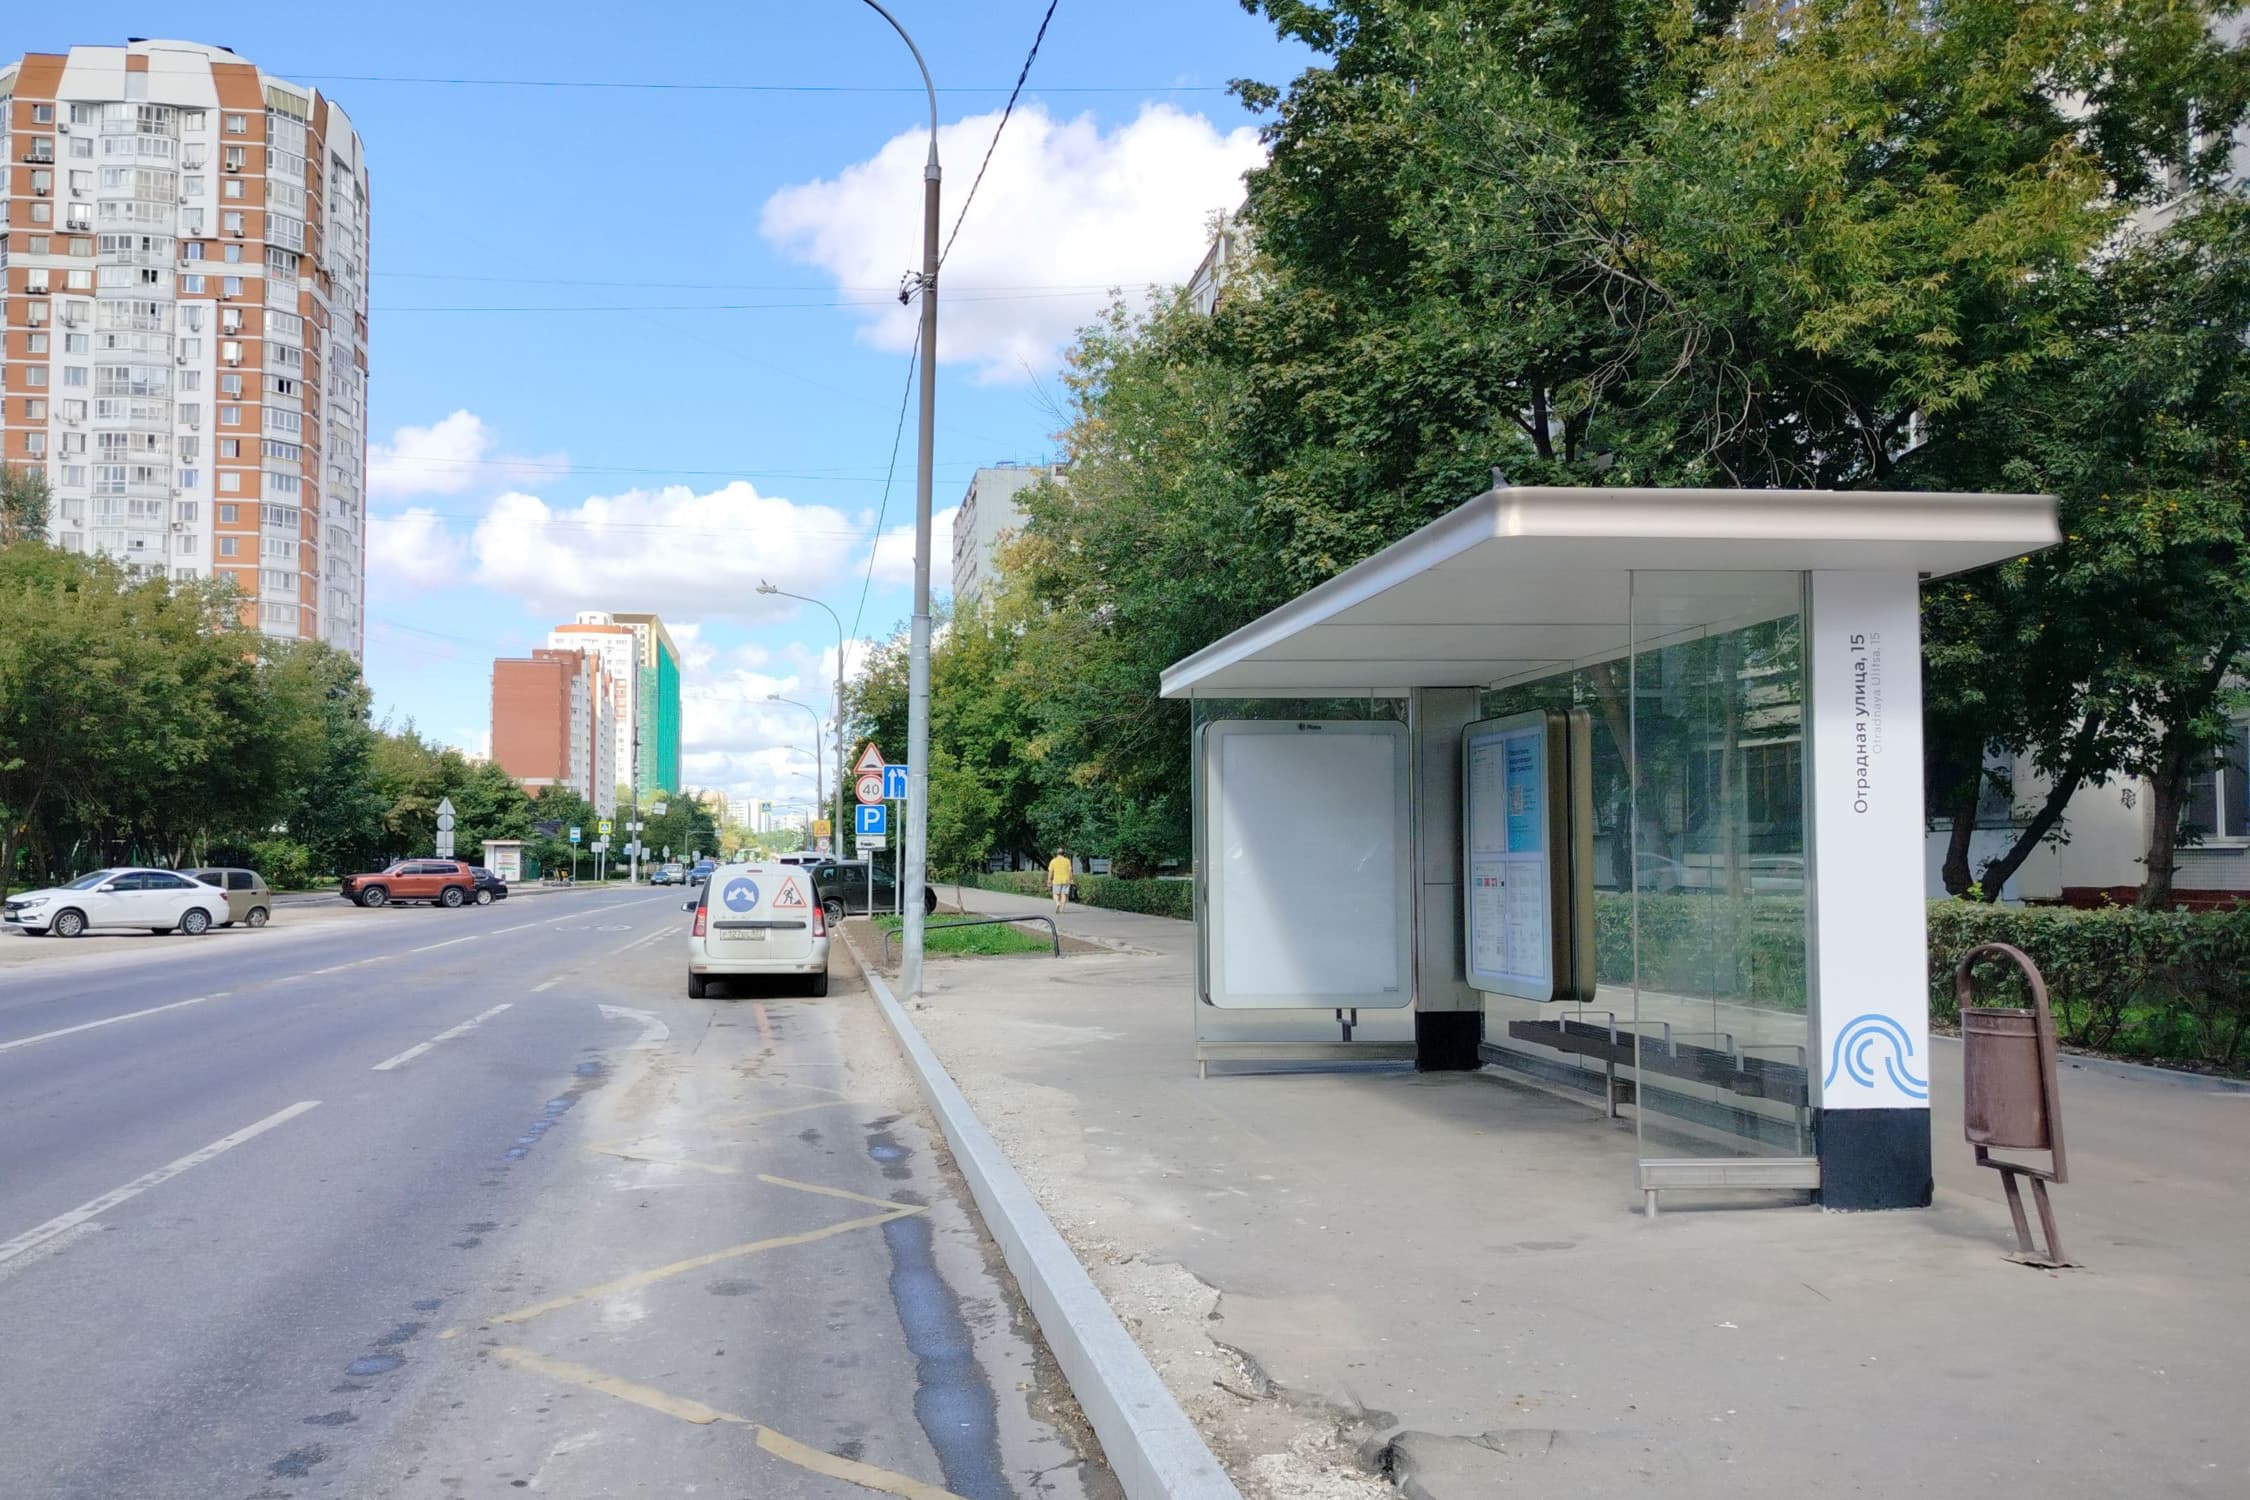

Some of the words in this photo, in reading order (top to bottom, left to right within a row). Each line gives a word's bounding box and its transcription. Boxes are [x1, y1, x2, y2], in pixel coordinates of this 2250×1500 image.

[1850, 634, 1865, 653] 15
[1869, 632, 1881, 645] 15
[1854, 658, 1869, 717] улица,
[1872, 689, 1884, 754] Otradnaya
[1853, 722, 1870, 814] Отрадная
[863, 784, 880, 796] 40
[864, 808, 881, 831] P
